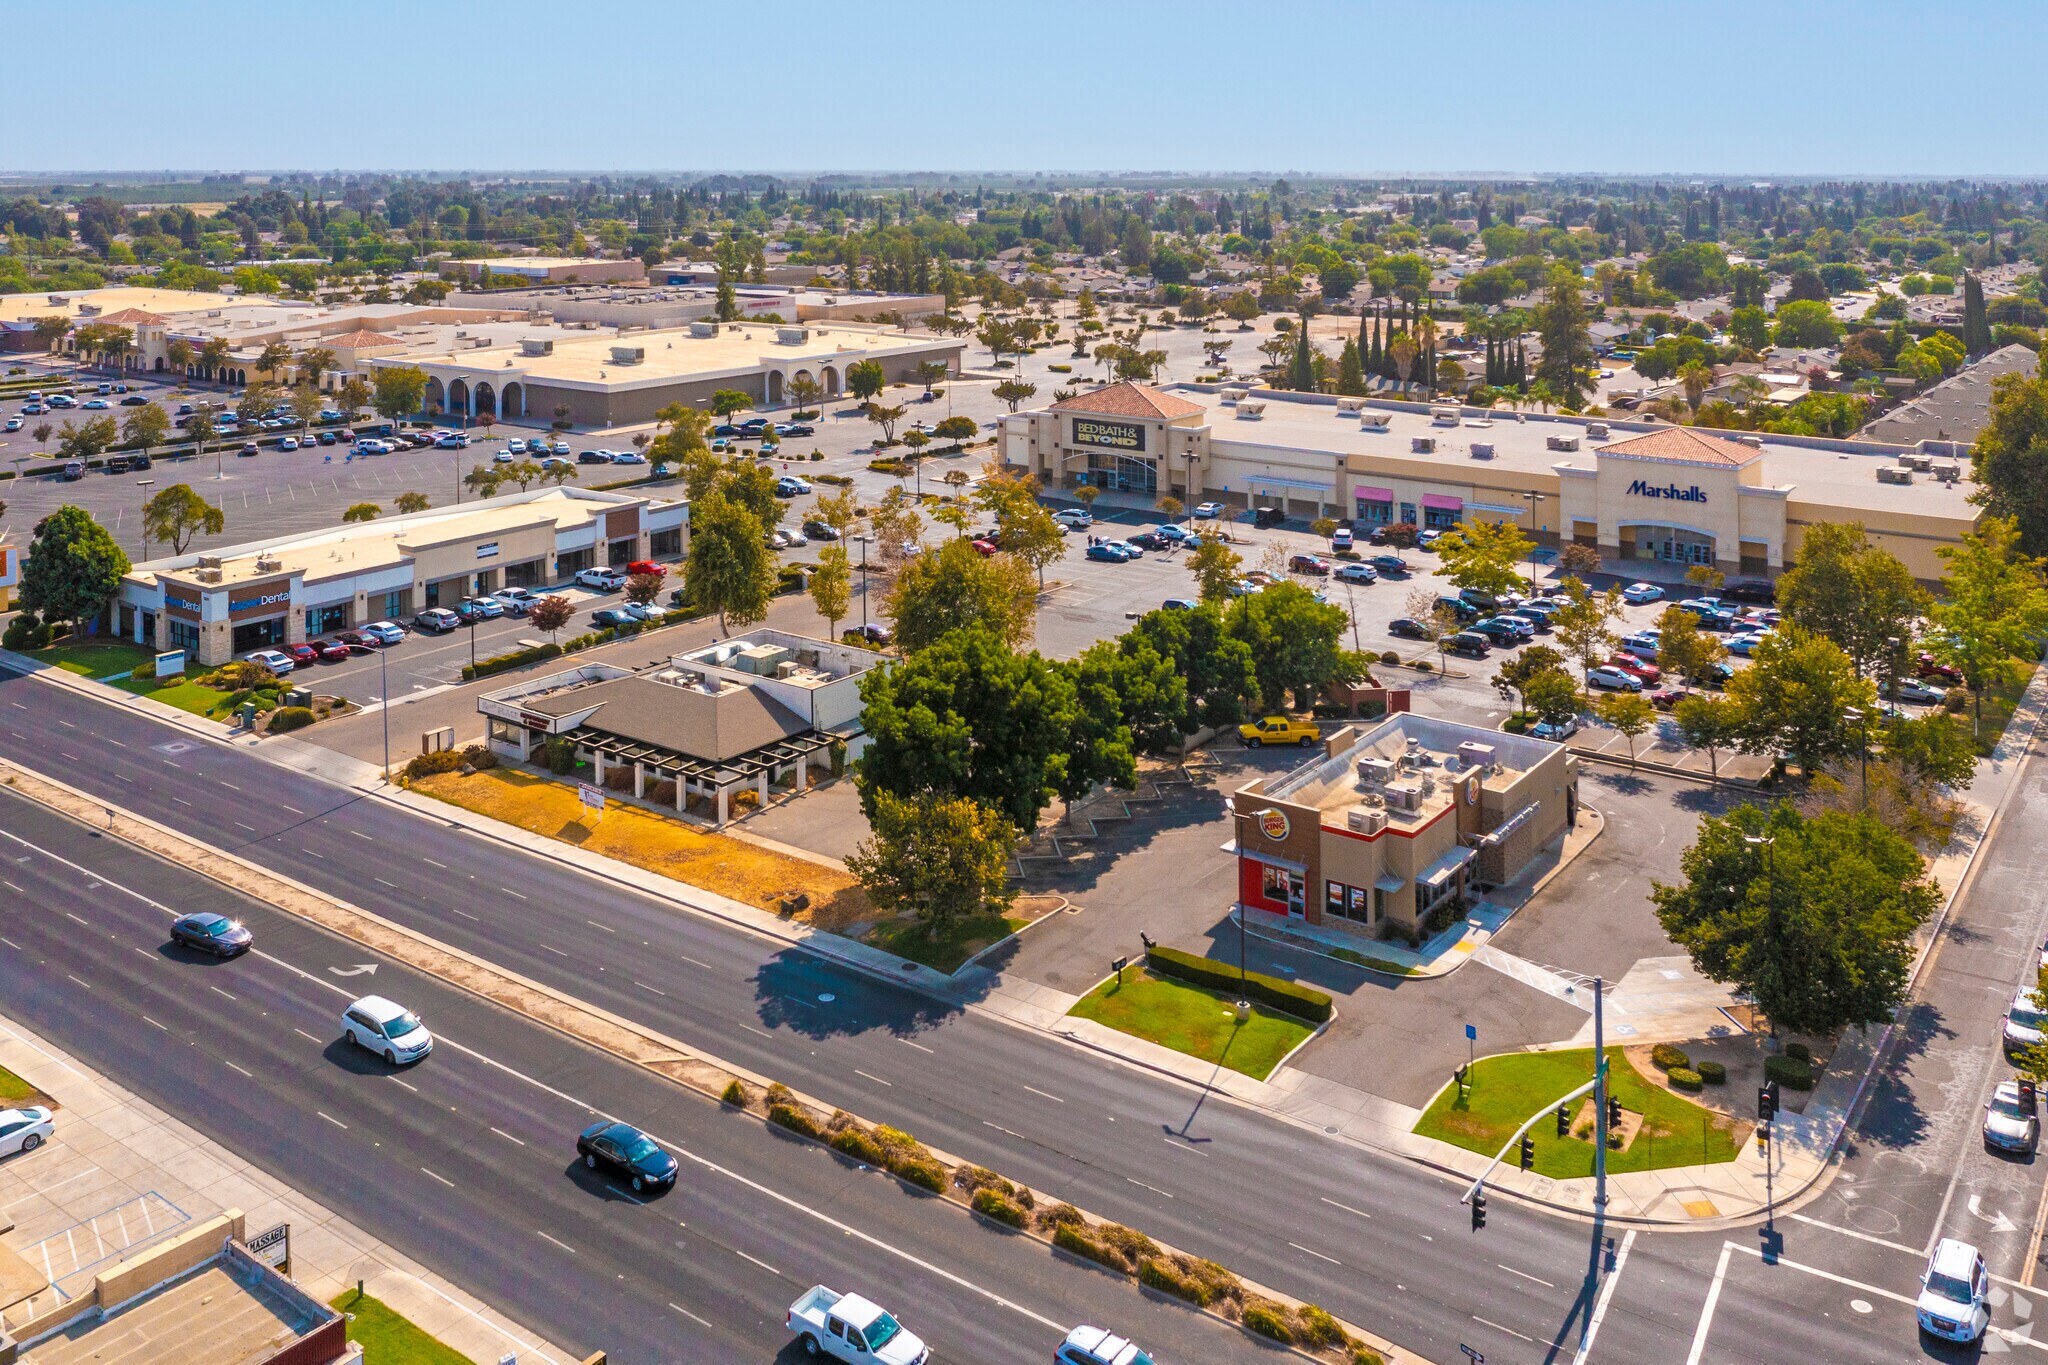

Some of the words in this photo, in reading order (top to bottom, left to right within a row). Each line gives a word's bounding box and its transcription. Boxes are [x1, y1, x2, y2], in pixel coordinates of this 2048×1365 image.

[1078, 423, 1098, 433] BED
[1100, 425, 1127, 437] BATH
[1127, 428, 1137, 438] &
[1078, 433, 1138, 446] BEYOND
[1626, 480, 1707, 503] Marshalls
[261, 591, 291, 605] Dental
[1264, 822, 1285, 830] KING
[250, 1228, 284, 1250] MASSAGE
